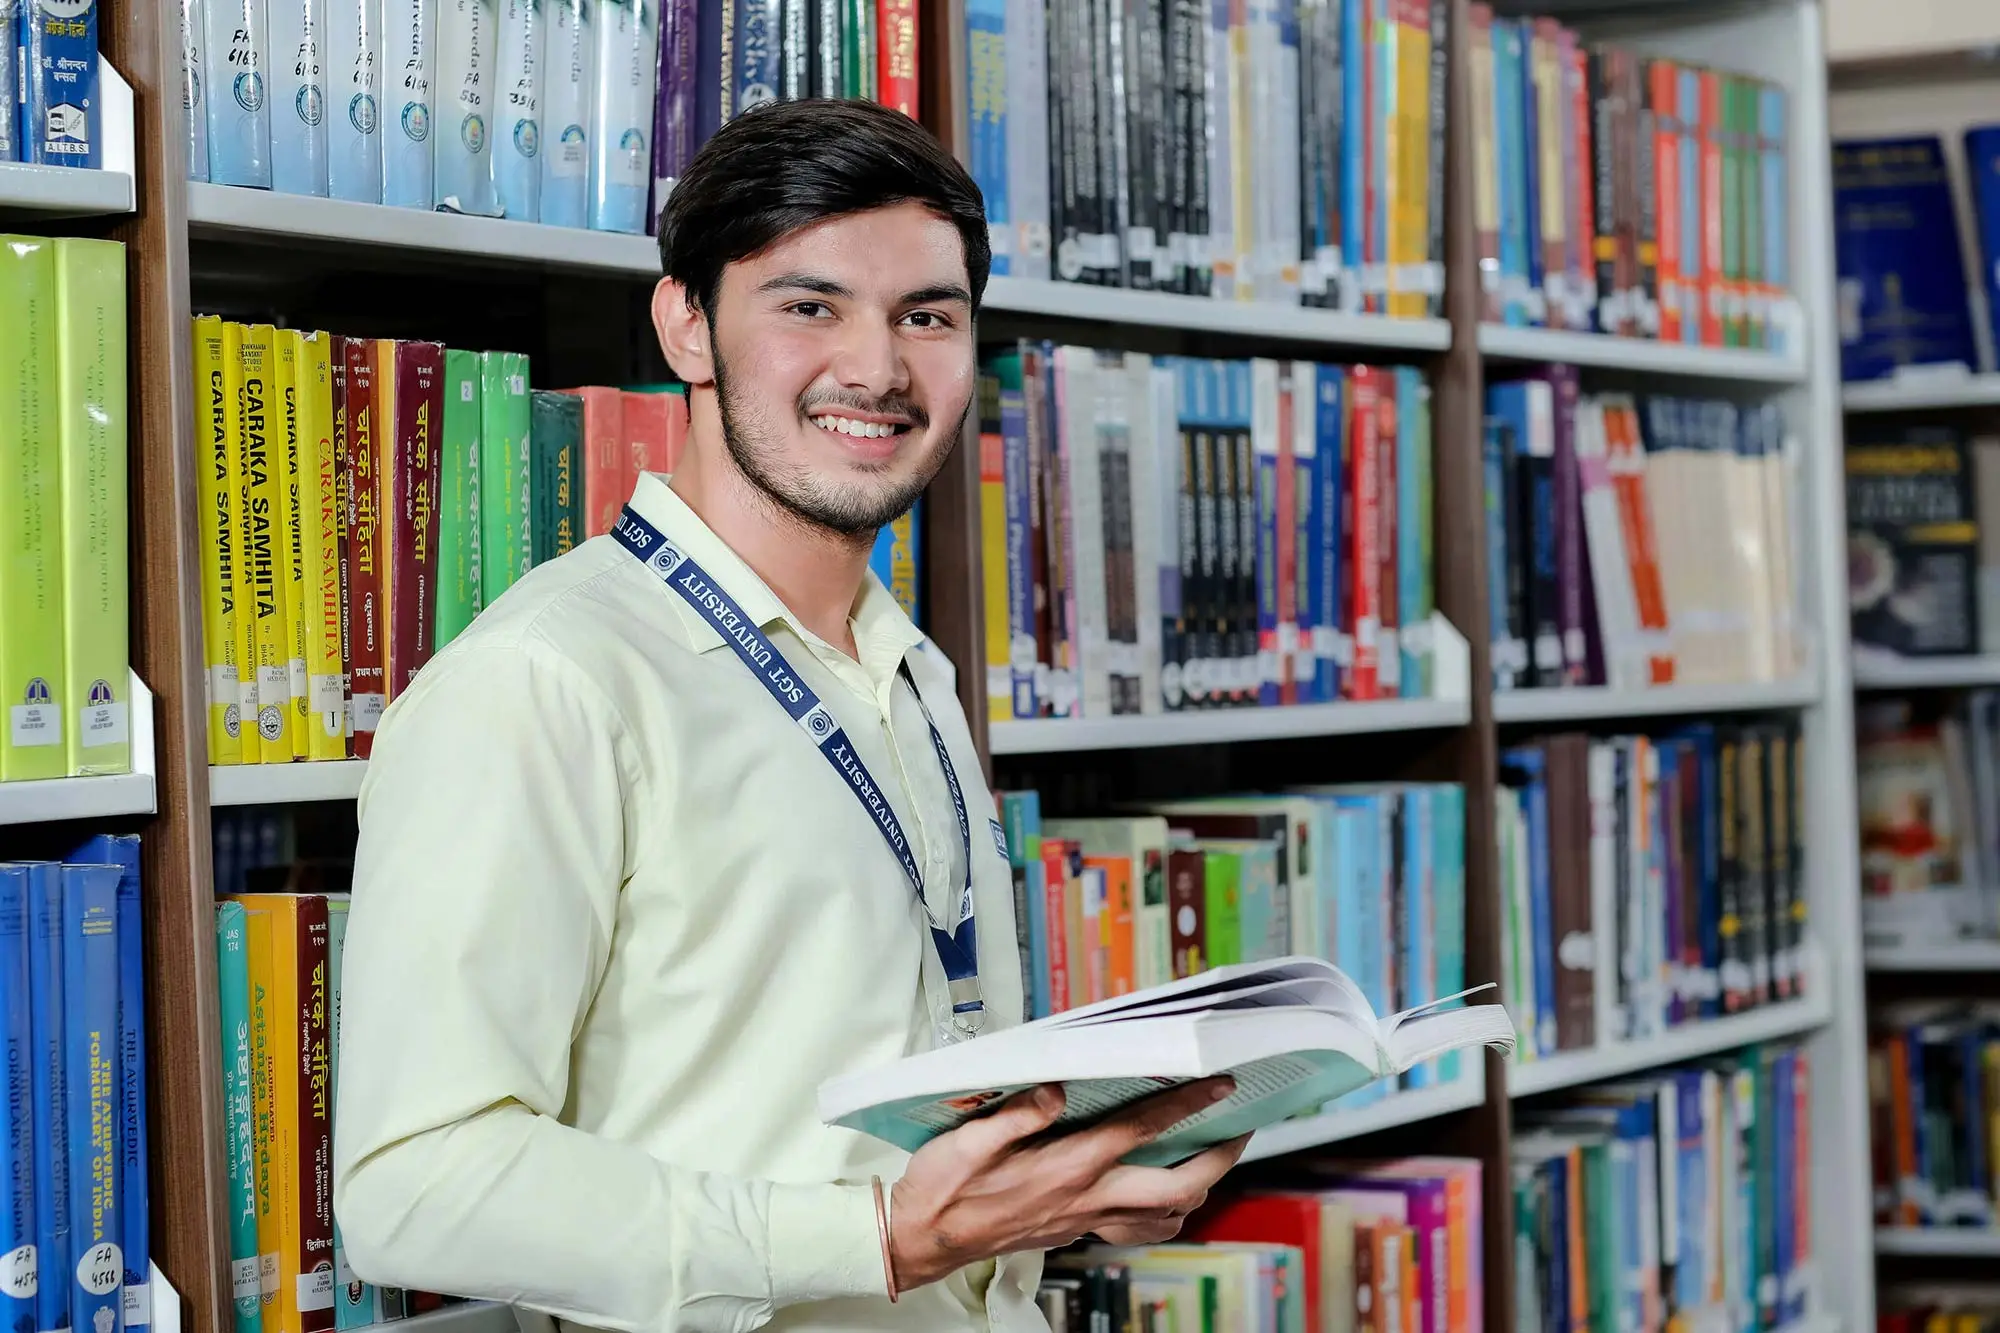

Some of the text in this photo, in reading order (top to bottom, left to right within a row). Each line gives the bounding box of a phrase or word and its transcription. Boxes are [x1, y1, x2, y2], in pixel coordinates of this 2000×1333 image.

[464, 72, 480, 86] FA
[210, 370, 228, 481] CARAKA
[245, 379, 266, 484] CARAKA
[557, 446, 570, 507] चरक
[318, 438, 334, 539] CARAKA
[355, 409, 375, 575] चरक संहिता
[413, 400, 433, 564] चरक संहिता
[622, 520, 653, 549] SGT
[355, 667, 383, 678] प्रथम भाग
[679, 572, 805, 705] SGT UNIVERSITY
[831, 742, 909, 852] UNIVERSITY
[226, 929, 239, 940] JAS
[227, 942, 239, 952] 174
[310, 959, 329, 1121] चरक संहिता
[8, 1037, 24, 1244] FORMULARY OF INDIA
[89, 1031, 104, 1242] FORMULARY OF INDIA
[102, 1060, 113, 1211] THE AYURVEDIC
[126, 1028, 138, 1168] THE AYURVEDIC
[267, 1056, 276, 1143] ILLUSTRATED
[14, 1247, 31, 1265] FA
[94, 1247, 112, 1265] FA
[306, 1238, 334, 1252] द्वितीय भा
